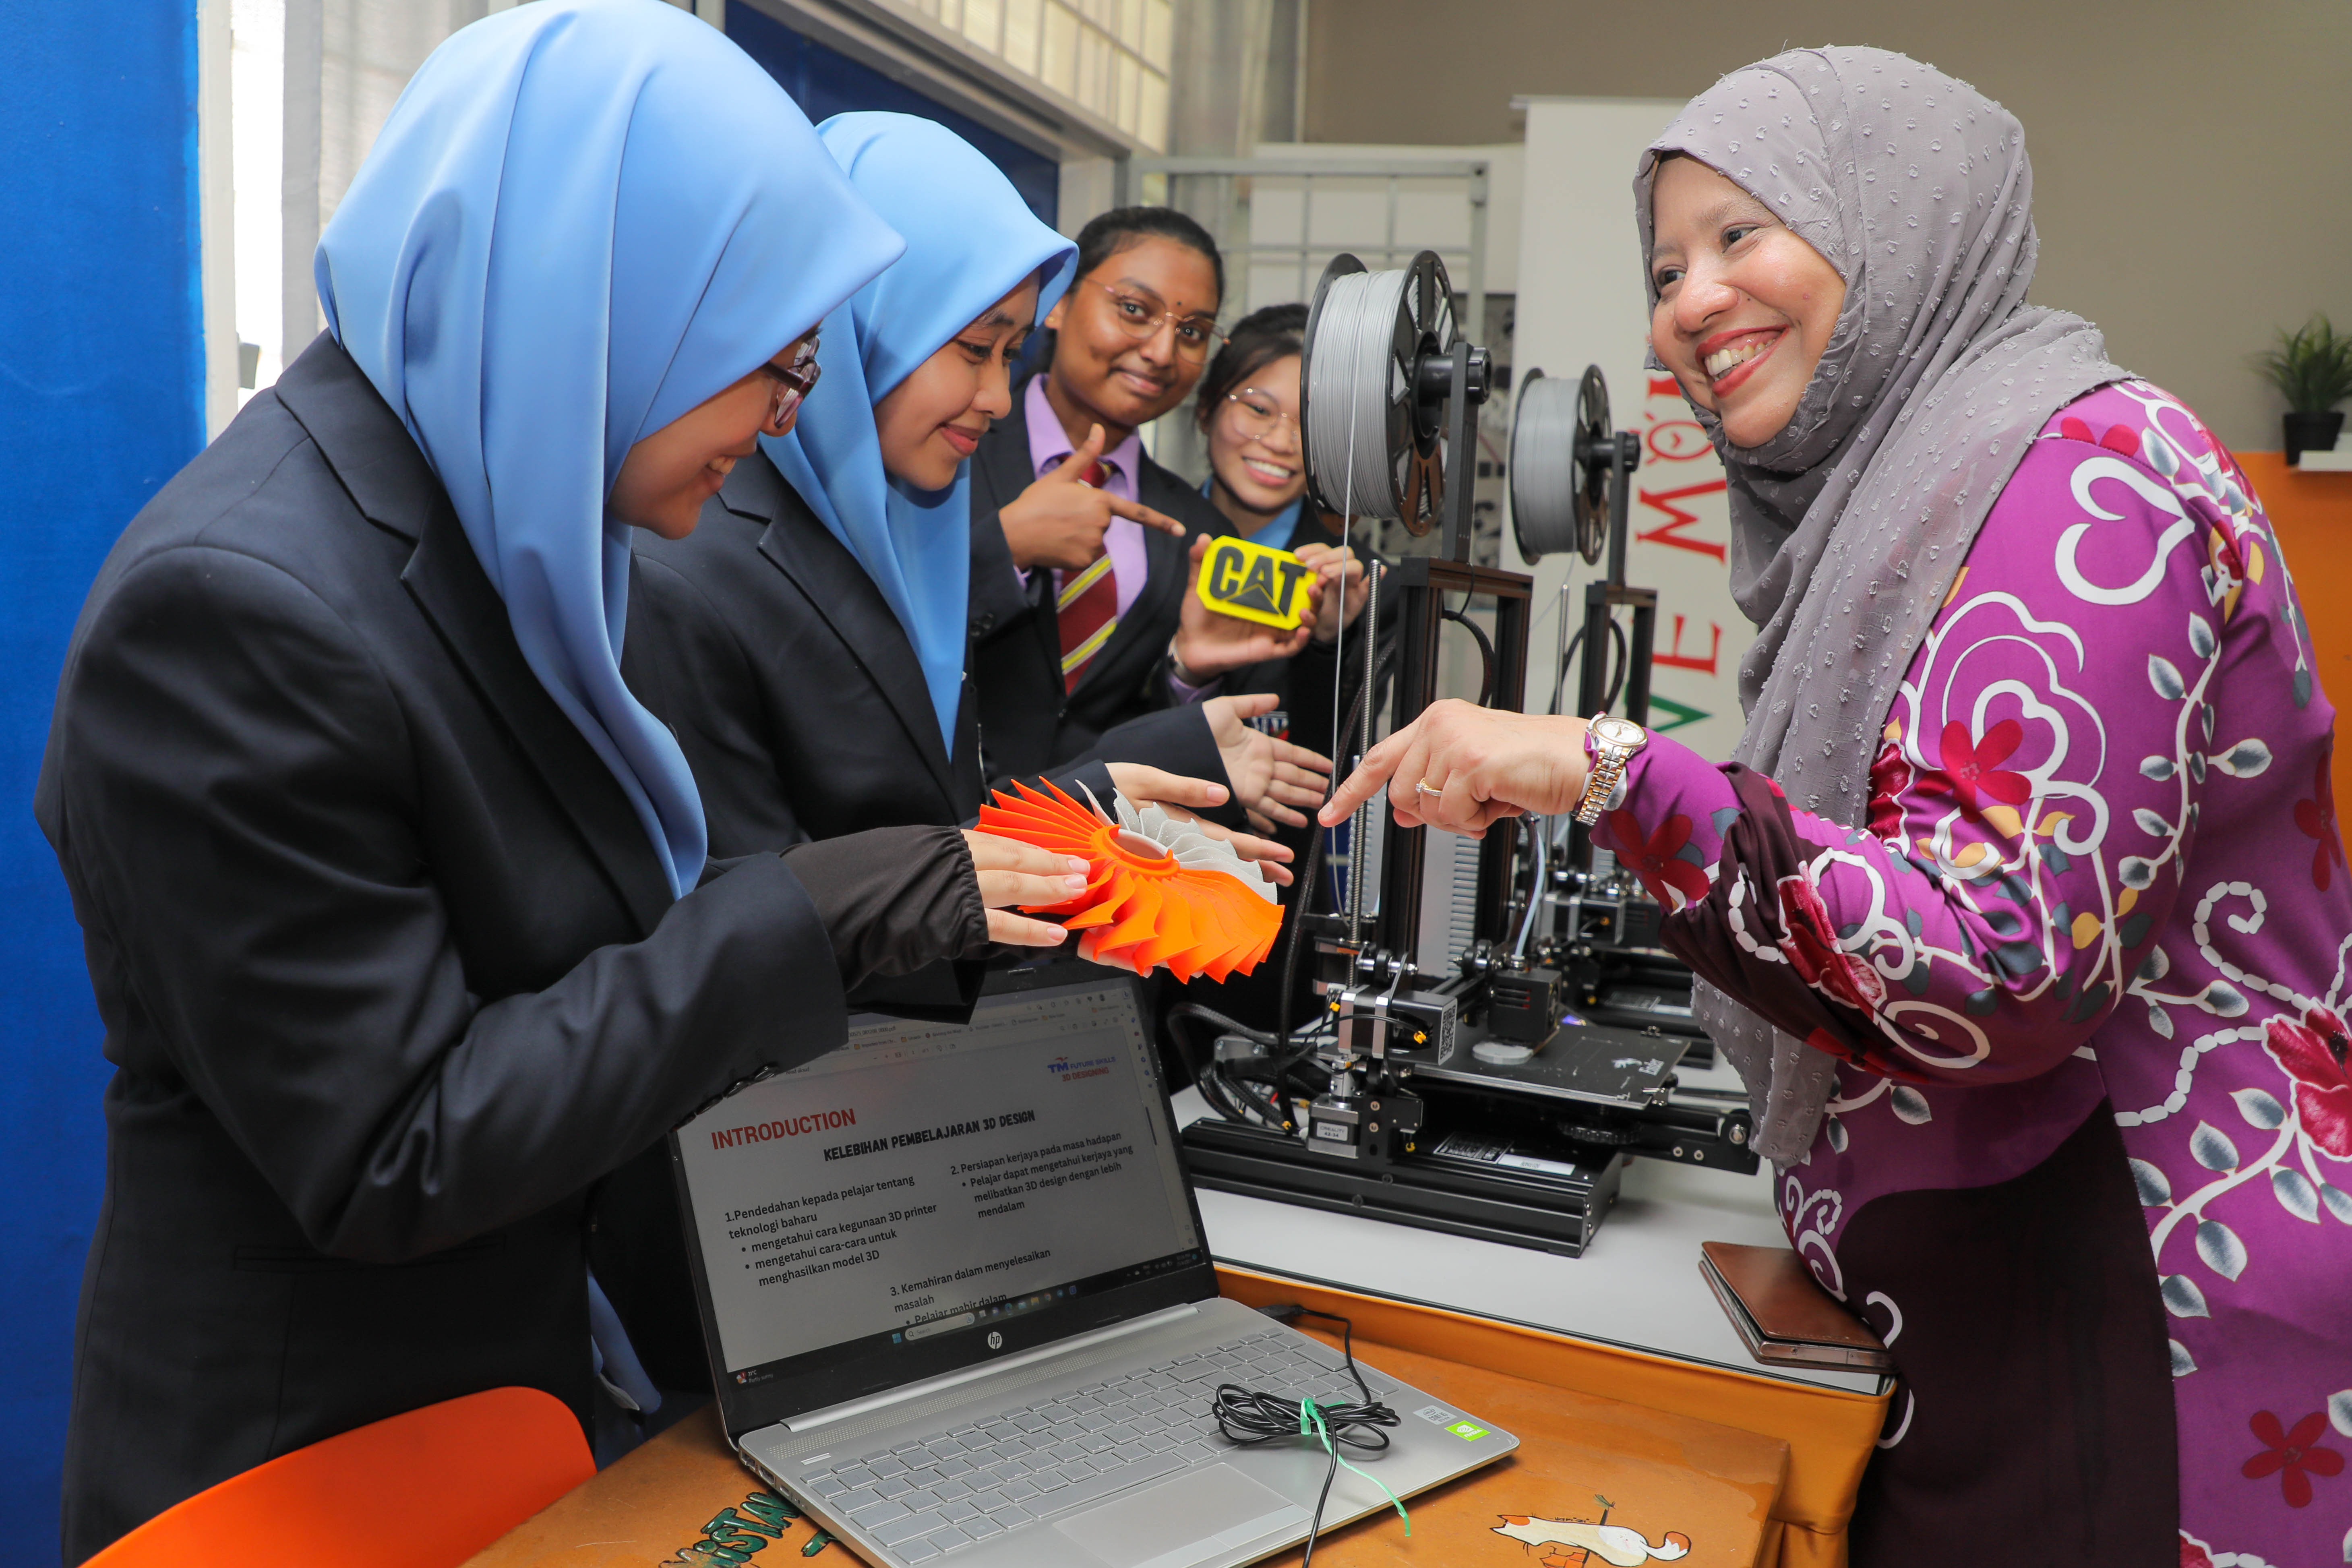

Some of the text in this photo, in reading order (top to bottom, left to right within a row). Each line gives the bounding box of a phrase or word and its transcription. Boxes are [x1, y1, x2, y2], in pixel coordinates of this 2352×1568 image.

[1209, 546, 1307, 617] CAT
[1047, 1056, 1116, 1073] TM FUTURE SKILLS
[1062, 1067, 1109, 1082] 3D DESIGNING
[711, 1108, 856, 1150] INTRODUCTION
[823, 1110, 1035, 1161] KELEBIHAN PEMBELAJARAN 3D DESIGN
[950, 1132, 1121, 1175] 2. Persiapan kerjaya pada masa hadapan
[970, 1145, 1134, 1187] Pelajar dapat mengetahui kerjaya yang
[725, 1176, 915, 1222] 1.Pendedahan kepada pelajar tentang
[974, 1162, 1122, 1203] melibatkan 3D design dengan lebih
[728, 1213, 817, 1239] teknologi baharu
[751, 1204, 937, 1252] mengetahui cara kegunaan 3D printer
[978, 1200, 1025, 1218] mendalam
[755, 1229, 898, 1269] mengetahui cara-cara untuk
[759, 1249, 880, 1286] menghasilkan model 3D
[890, 1249, 1051, 1296] 3. Kemahiran dalam menyelesaikan
[894, 1294, 935, 1313] masalah
[950, 1301, 976, 1316] mahir
[979, 1293, 1007, 1307] dalam
[989, 1332, 1001, 1349] hp
[1463, 1429, 1483, 1438] NVIDIA
